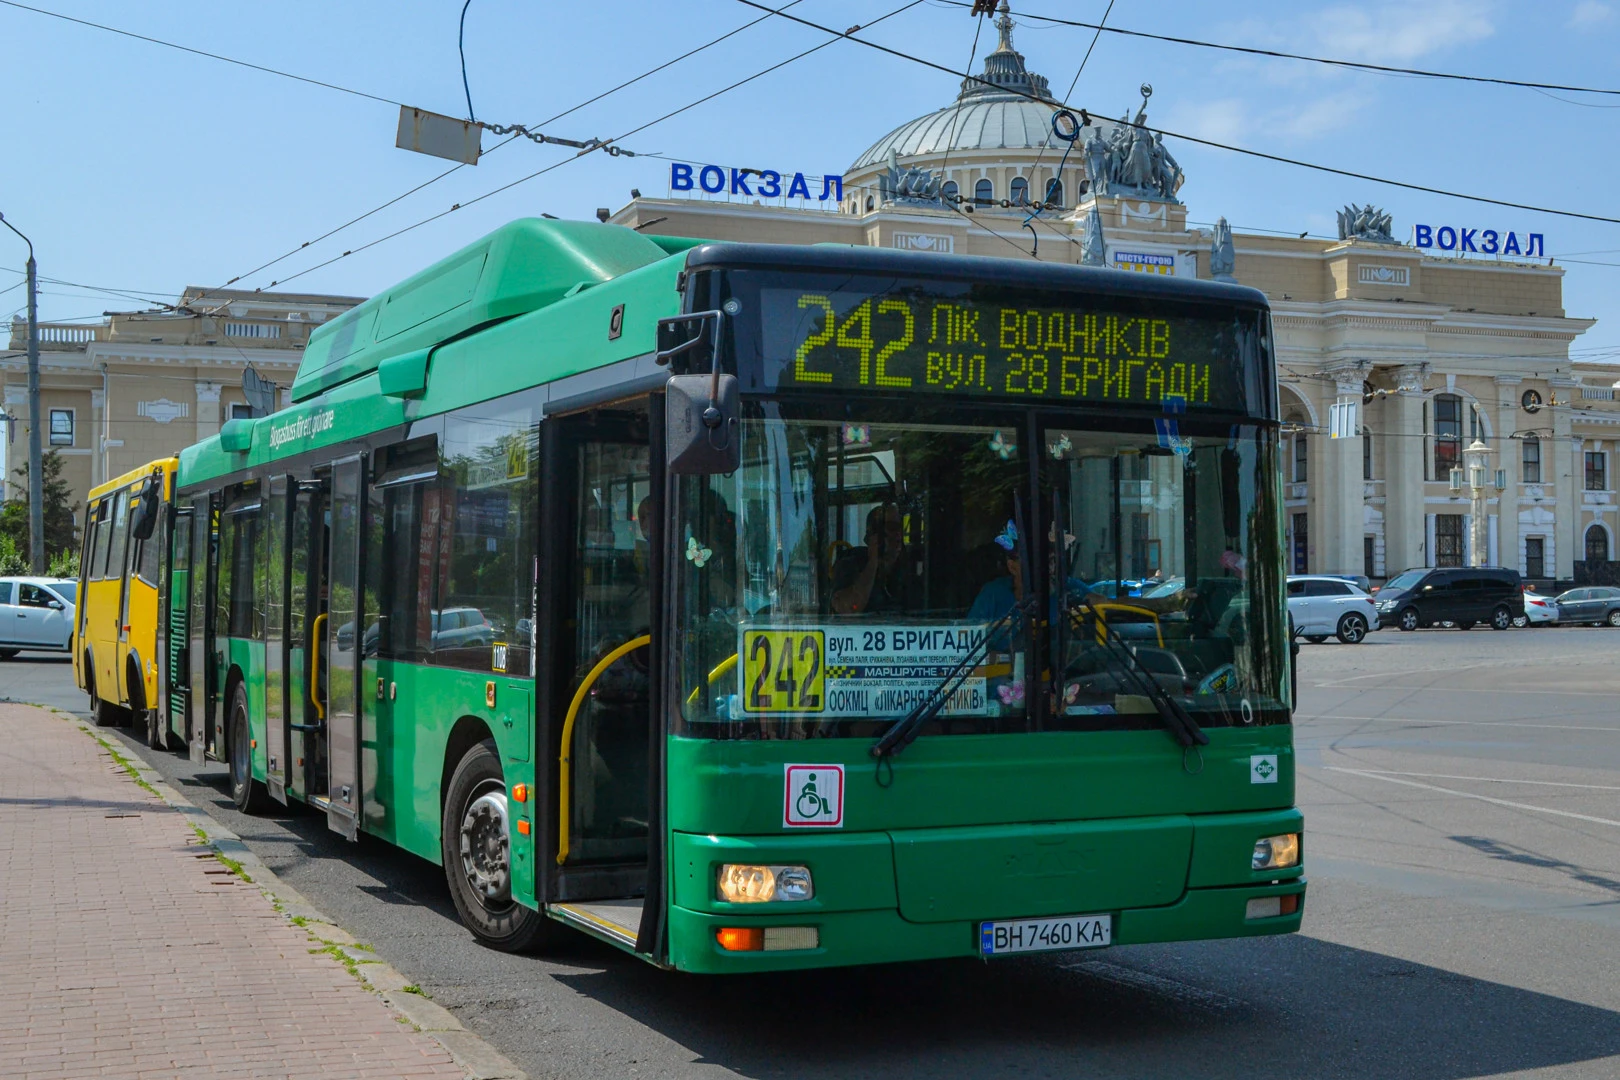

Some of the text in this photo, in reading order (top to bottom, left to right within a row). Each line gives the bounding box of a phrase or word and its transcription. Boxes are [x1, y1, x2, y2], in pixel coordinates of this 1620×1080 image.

[670, 163, 843, 202] ВОКЗАЛ
[1414, 224, 1544, 257] ВОКЗАЛ
[1117, 253, 1171, 265] МІСТУ-ГЕРОЮ
[795, 294, 915, 388] 242
[1000, 308, 1170, 358] ВОДНИКІВ
[1006, 353, 1048, 394] 28
[1060, 355, 1210, 402] БРИГАДИ
[829, 630, 982, 656] вул. 28 БРИГАДИ
[750, 634, 820, 707] 242
[864, 667, 937, 677] МАРШРУТНЕ
[829, 690, 868, 715] ООКМЦ
[1257, 764, 1272, 773] CNG
[995, 920, 1104, 949] BH 7460 KA
